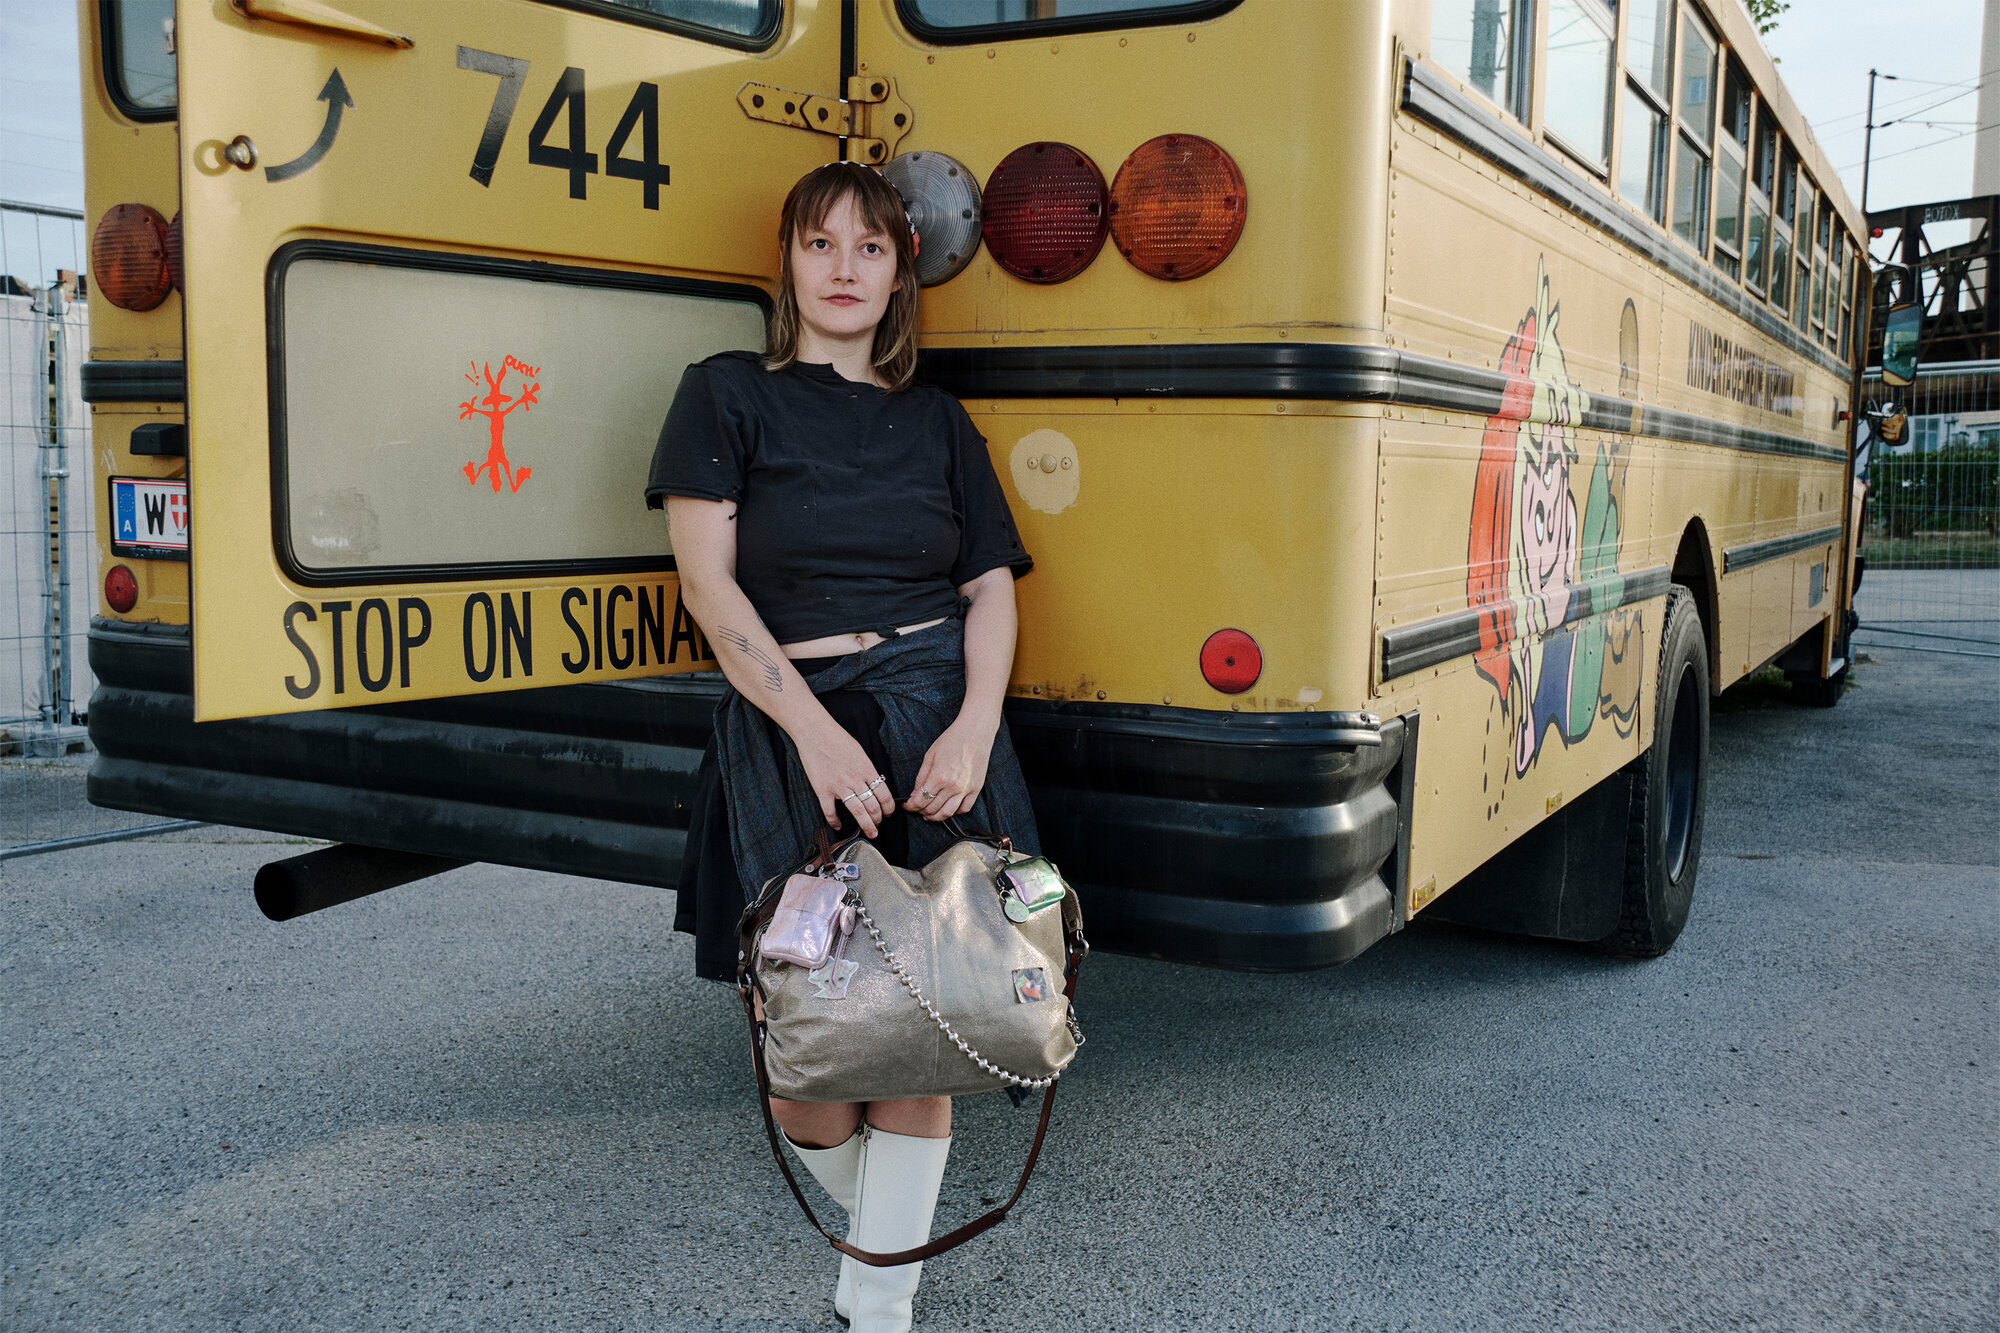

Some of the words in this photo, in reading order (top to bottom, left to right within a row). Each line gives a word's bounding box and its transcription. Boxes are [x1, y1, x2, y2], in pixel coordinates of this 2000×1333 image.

[456, 44, 670, 211] 744
[123, 519, 133, 533] A
[144, 492, 167, 536] W
[283, 597, 432, 700] STOP
[462, 591, 533, 683] ON
